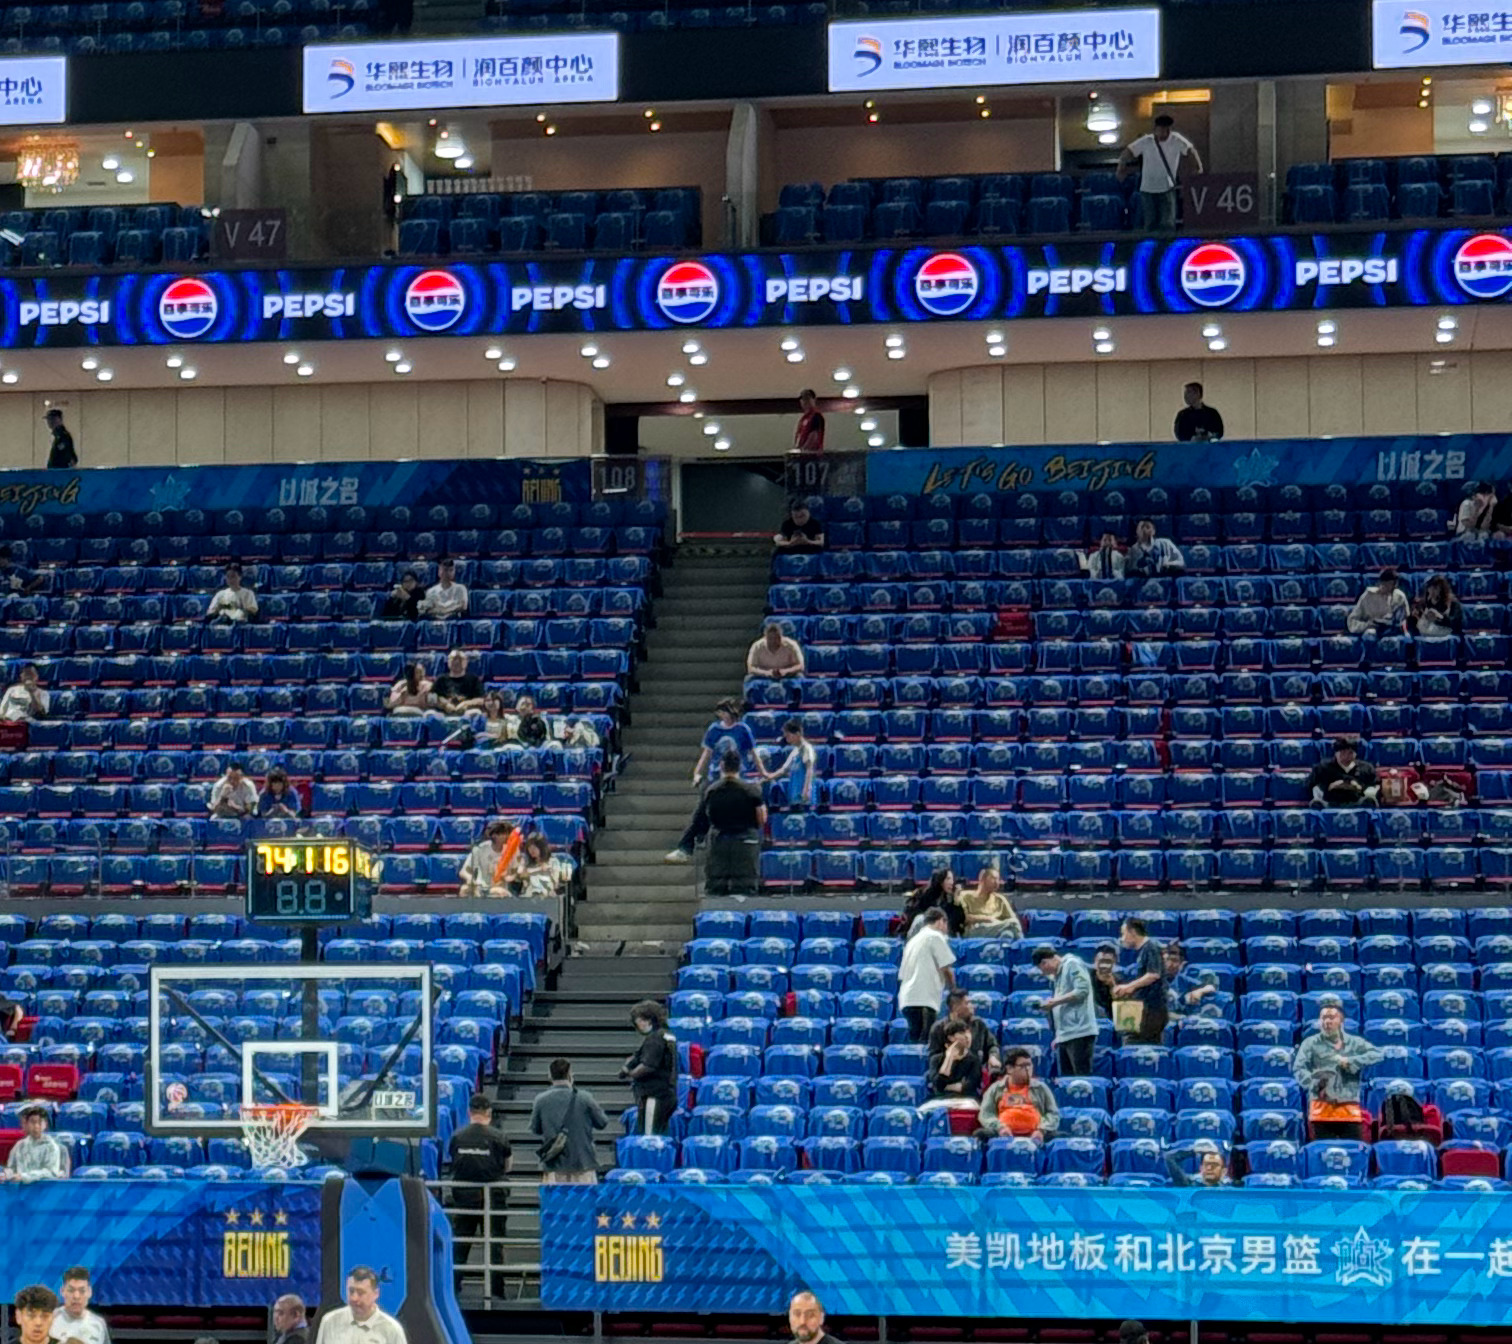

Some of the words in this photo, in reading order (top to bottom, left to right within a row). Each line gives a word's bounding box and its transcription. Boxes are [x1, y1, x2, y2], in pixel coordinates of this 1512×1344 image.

[894, 36, 986, 59] 华熙生物
[1008, 29, 1133, 56] 润百颜中心
[365, 59, 453, 81] 华熙生物
[474, 54, 593, 78] 润百颜中心
[1191, 189, 1208, 214] V
[1216, 185, 1253, 213] 46
[224, 222, 243, 248] V
[248, 219, 281, 248] 47
[1028, 269, 1125, 293] PEPSI
[1297, 260, 1396, 284] PEPSI
[512, 286, 604, 309] PEPSI
[767, 277, 861, 302] PEPSI
[21, 301, 108, 324] PEPSI
[264, 294, 354, 317] PEPSI
[1376, 450, 1467, 482] 以城之名
[278, 476, 360, 507] 以城之名
[223, 1231, 290, 1278] BEIJING
[594, 1234, 663, 1283] BEIJING
[945, 1232, 1323, 1276] 美凯地板和北京男篮
